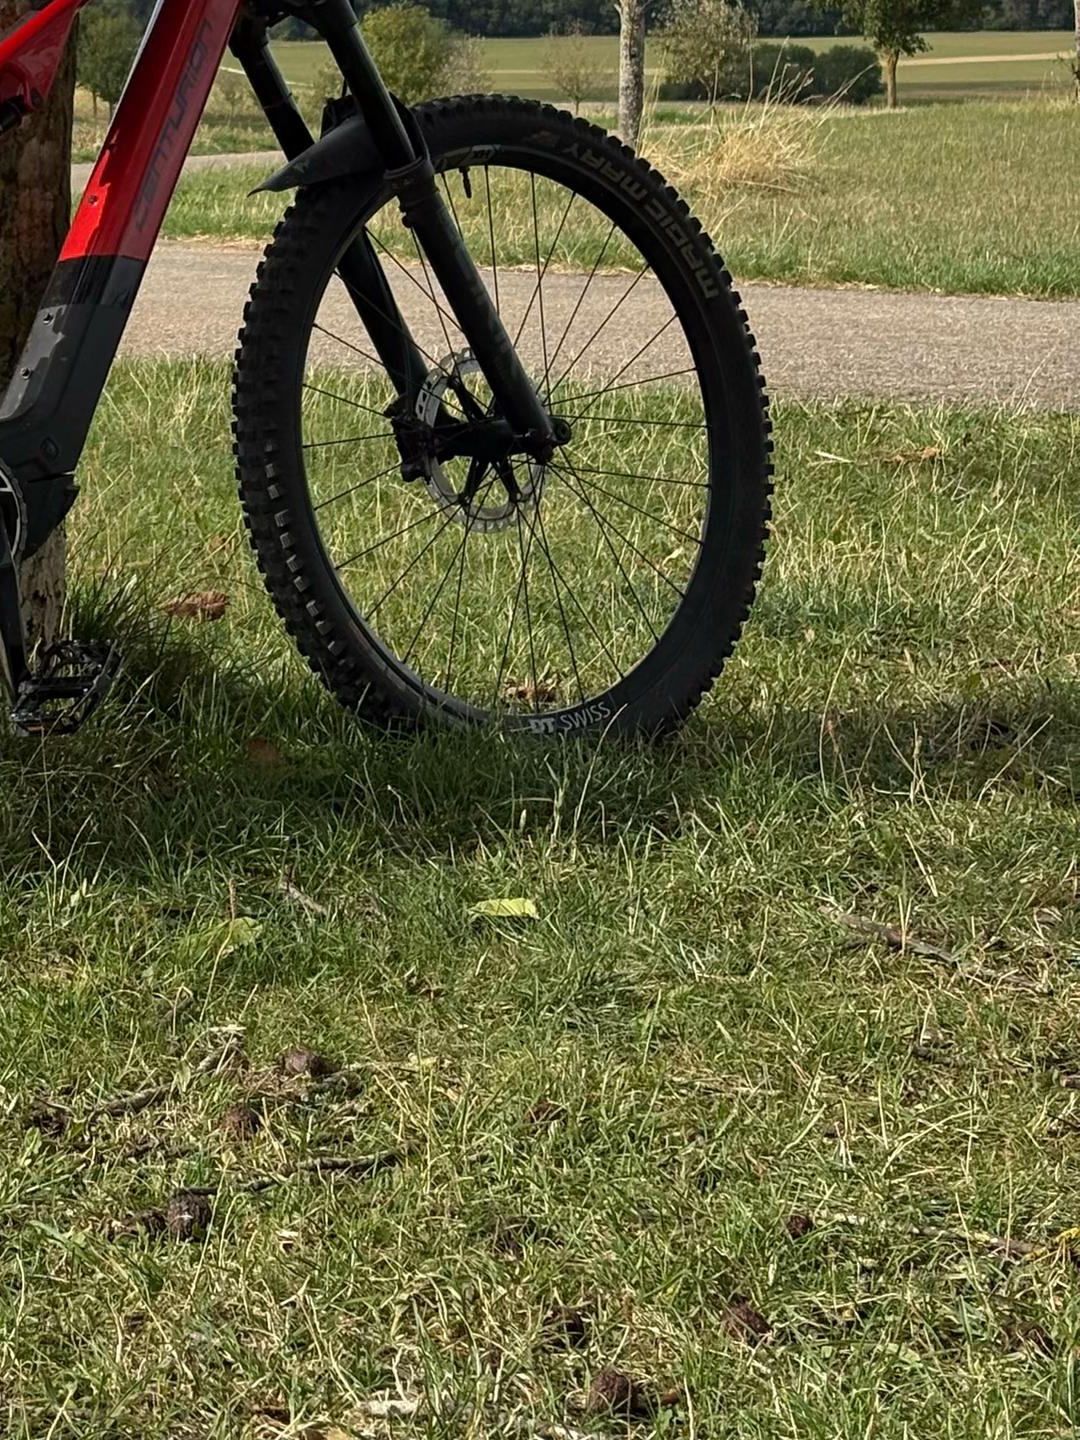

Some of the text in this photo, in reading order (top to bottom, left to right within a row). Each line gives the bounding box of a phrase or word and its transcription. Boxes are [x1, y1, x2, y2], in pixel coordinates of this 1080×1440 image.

[135, 18, 214, 233] CENTURION
[563, 143, 718, 299] MAGIC MARY
[529, 702, 611, 733] DT SWISS
